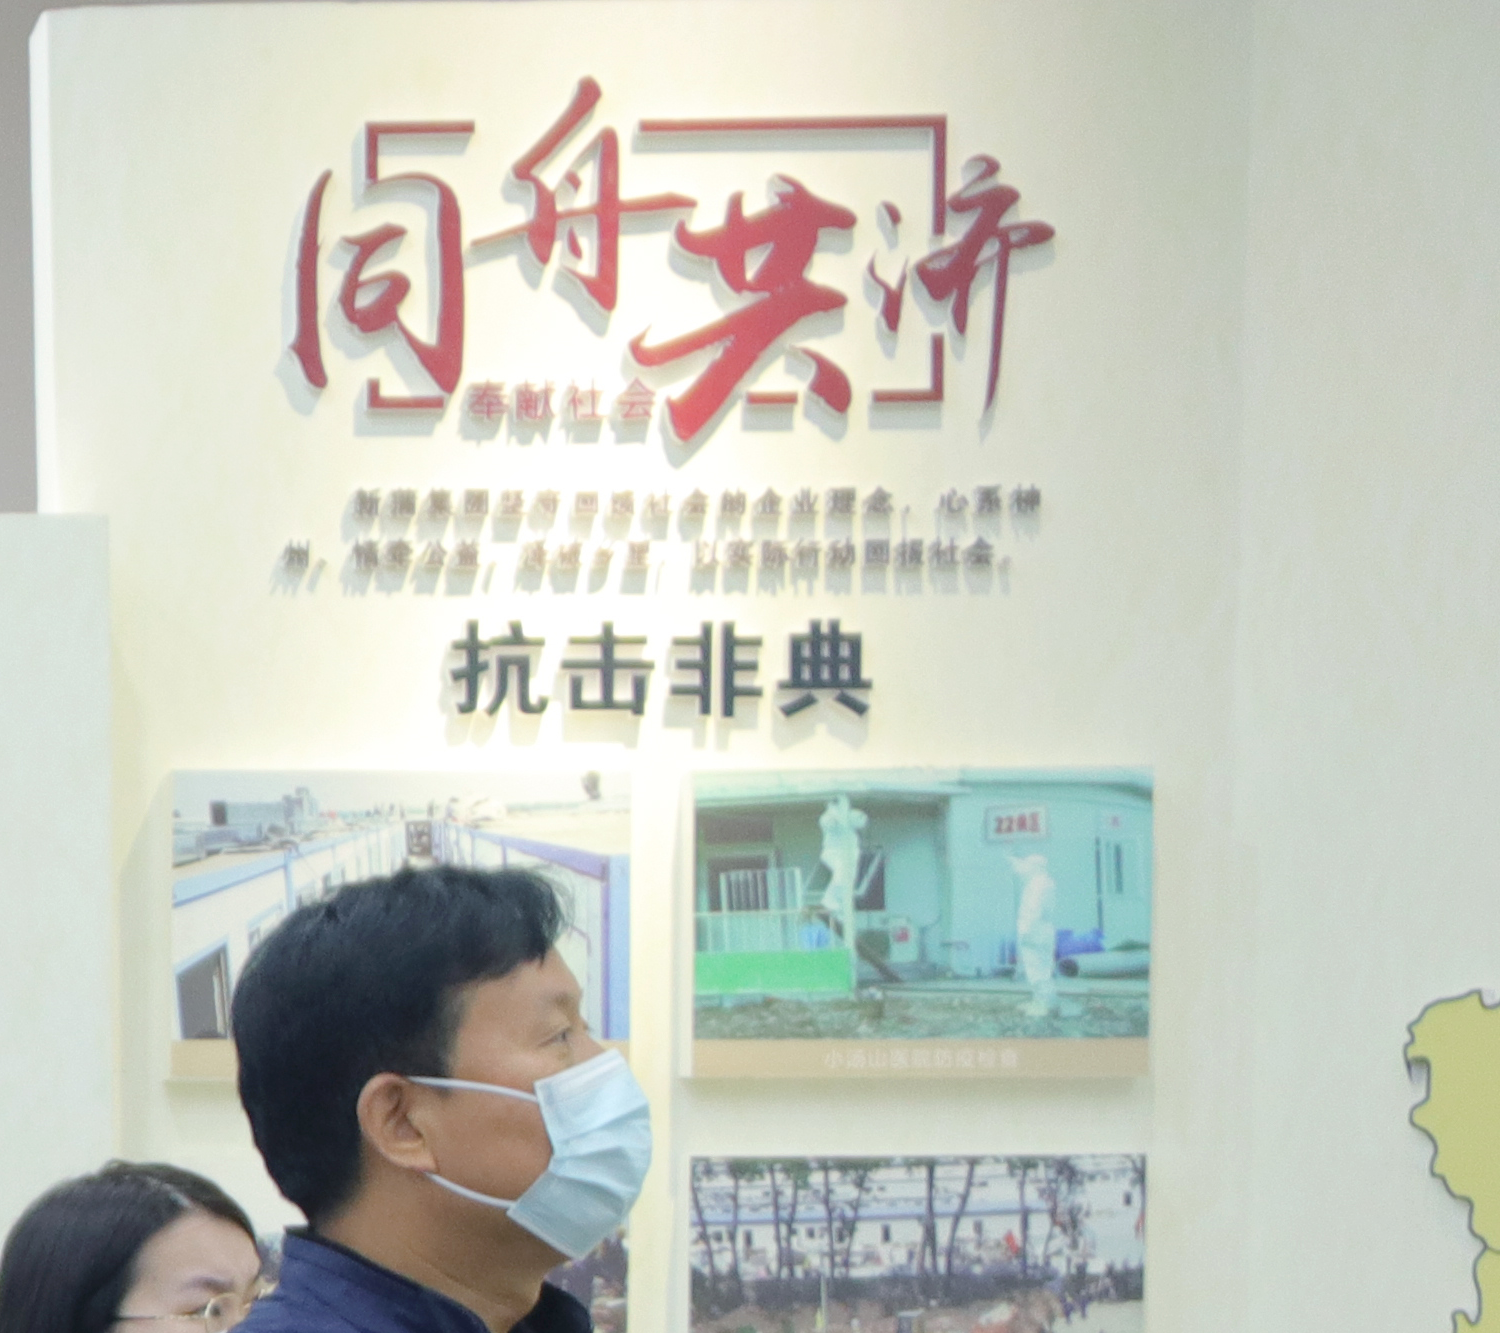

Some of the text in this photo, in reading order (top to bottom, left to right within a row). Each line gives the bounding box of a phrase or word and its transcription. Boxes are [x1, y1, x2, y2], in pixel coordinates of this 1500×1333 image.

[289, 76, 1055, 443] 同舟共济
[467, 378, 658, 421] 奉献社会
[449, 619, 874, 718] 抗击非典
